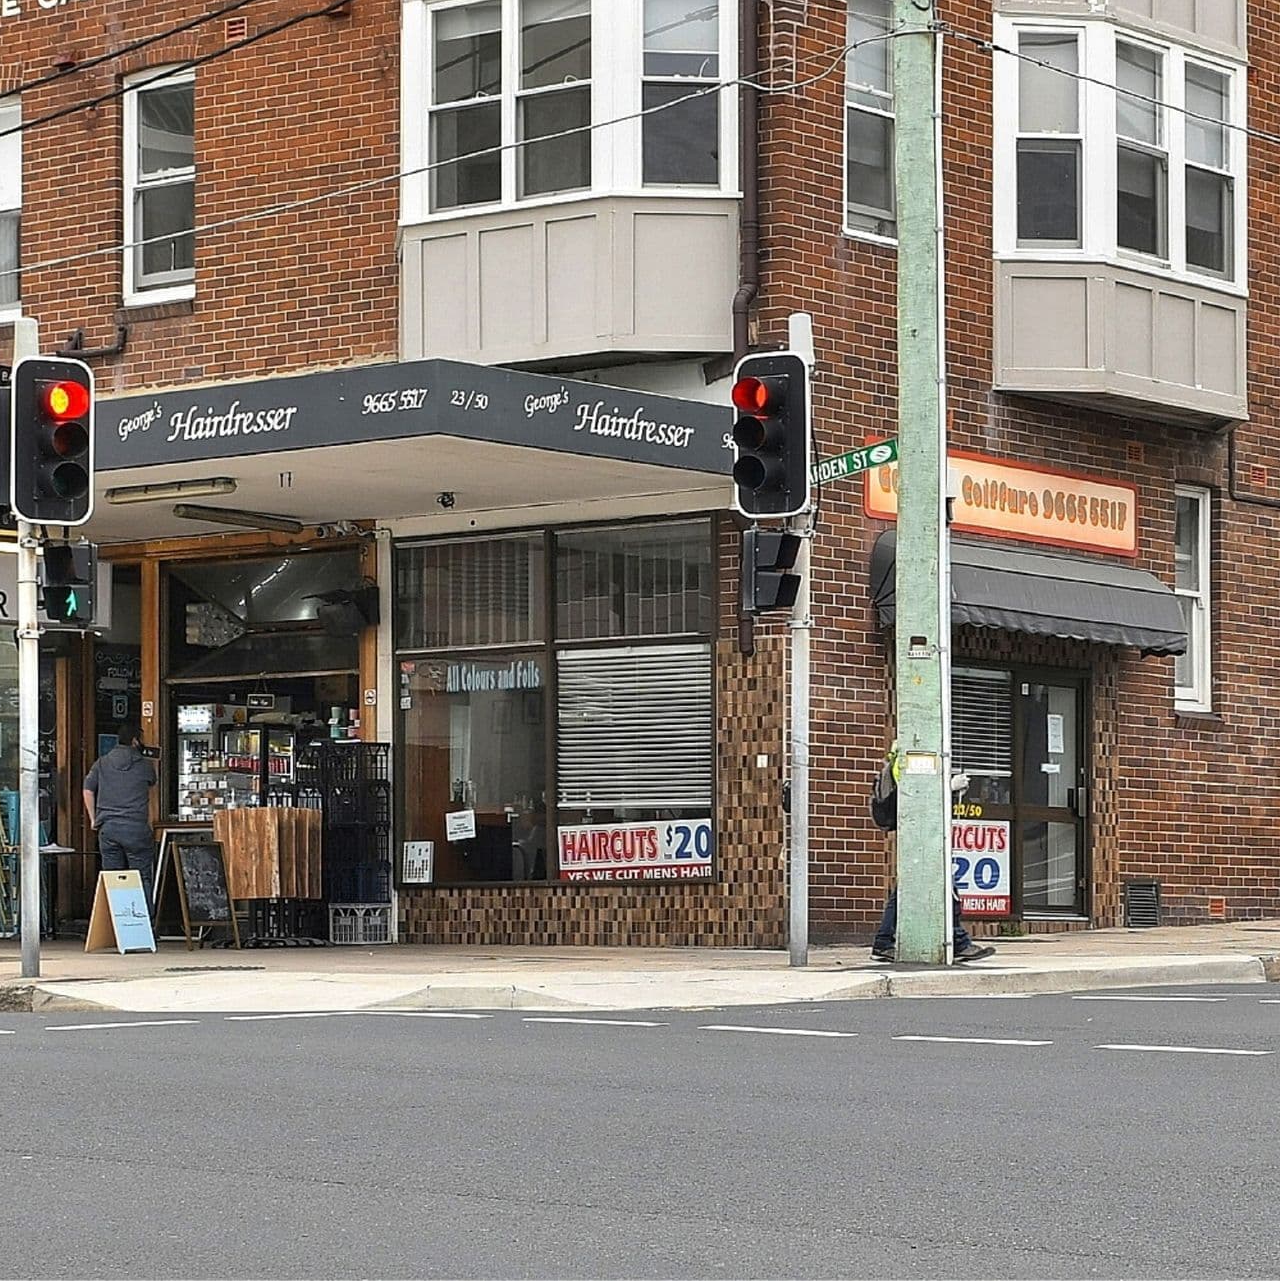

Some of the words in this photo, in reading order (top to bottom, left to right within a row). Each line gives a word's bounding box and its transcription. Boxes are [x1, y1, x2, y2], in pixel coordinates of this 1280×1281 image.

[167, 401, 297, 441] Hairdresser
[362, 391, 398, 414] 9665
[398, 389, 428, 410] 5517
[450, 390, 488, 410] 23/50
[574, 401, 694, 448] Hairdresser
[852, 451, 868, 469] ST
[961, 475, 1039, 517] Coiffure
[447, 664, 459, 692] All
[498, 662, 515, 689] and
[561, 829, 658, 864] HAIRCUTS
[666, 824, 712, 859] $20
[952, 826, 1006, 851] RCUTS
[592, 870, 613, 880] WE
[615, 869, 640, 880] CUT
[643, 867, 677, 879] MENS
[681, 865, 712, 877] HAIR
[963, 898, 985, 911] MENS
[986, 898, 1007, 911] HAIR
